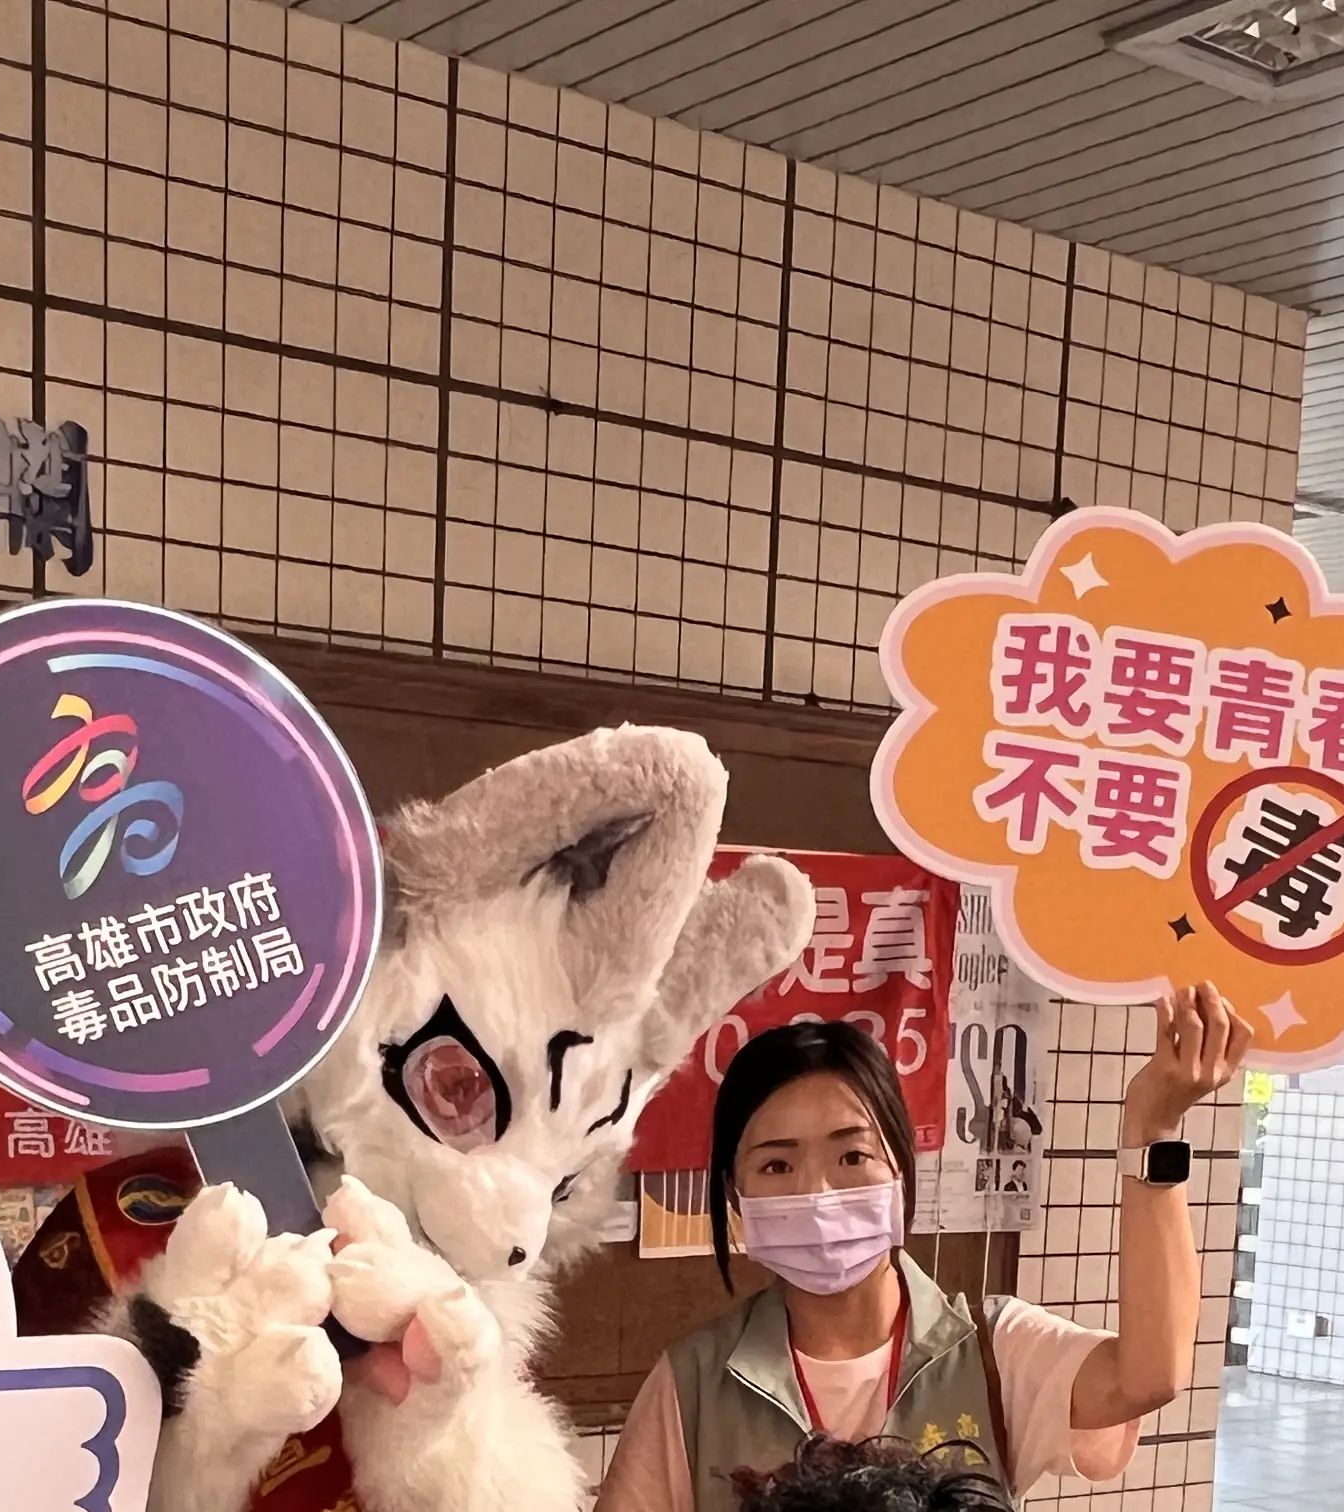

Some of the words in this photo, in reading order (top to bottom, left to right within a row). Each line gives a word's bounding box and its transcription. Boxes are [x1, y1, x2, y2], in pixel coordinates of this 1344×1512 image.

[984, 742, 1181, 866] 不要
[24, 871, 280, 993] 高雄市政府
[51, 926, 304, 1045] 毒品防制局
[778, 884, 934, 997] 是真
[4, 1108, 113, 1159] 高雄
